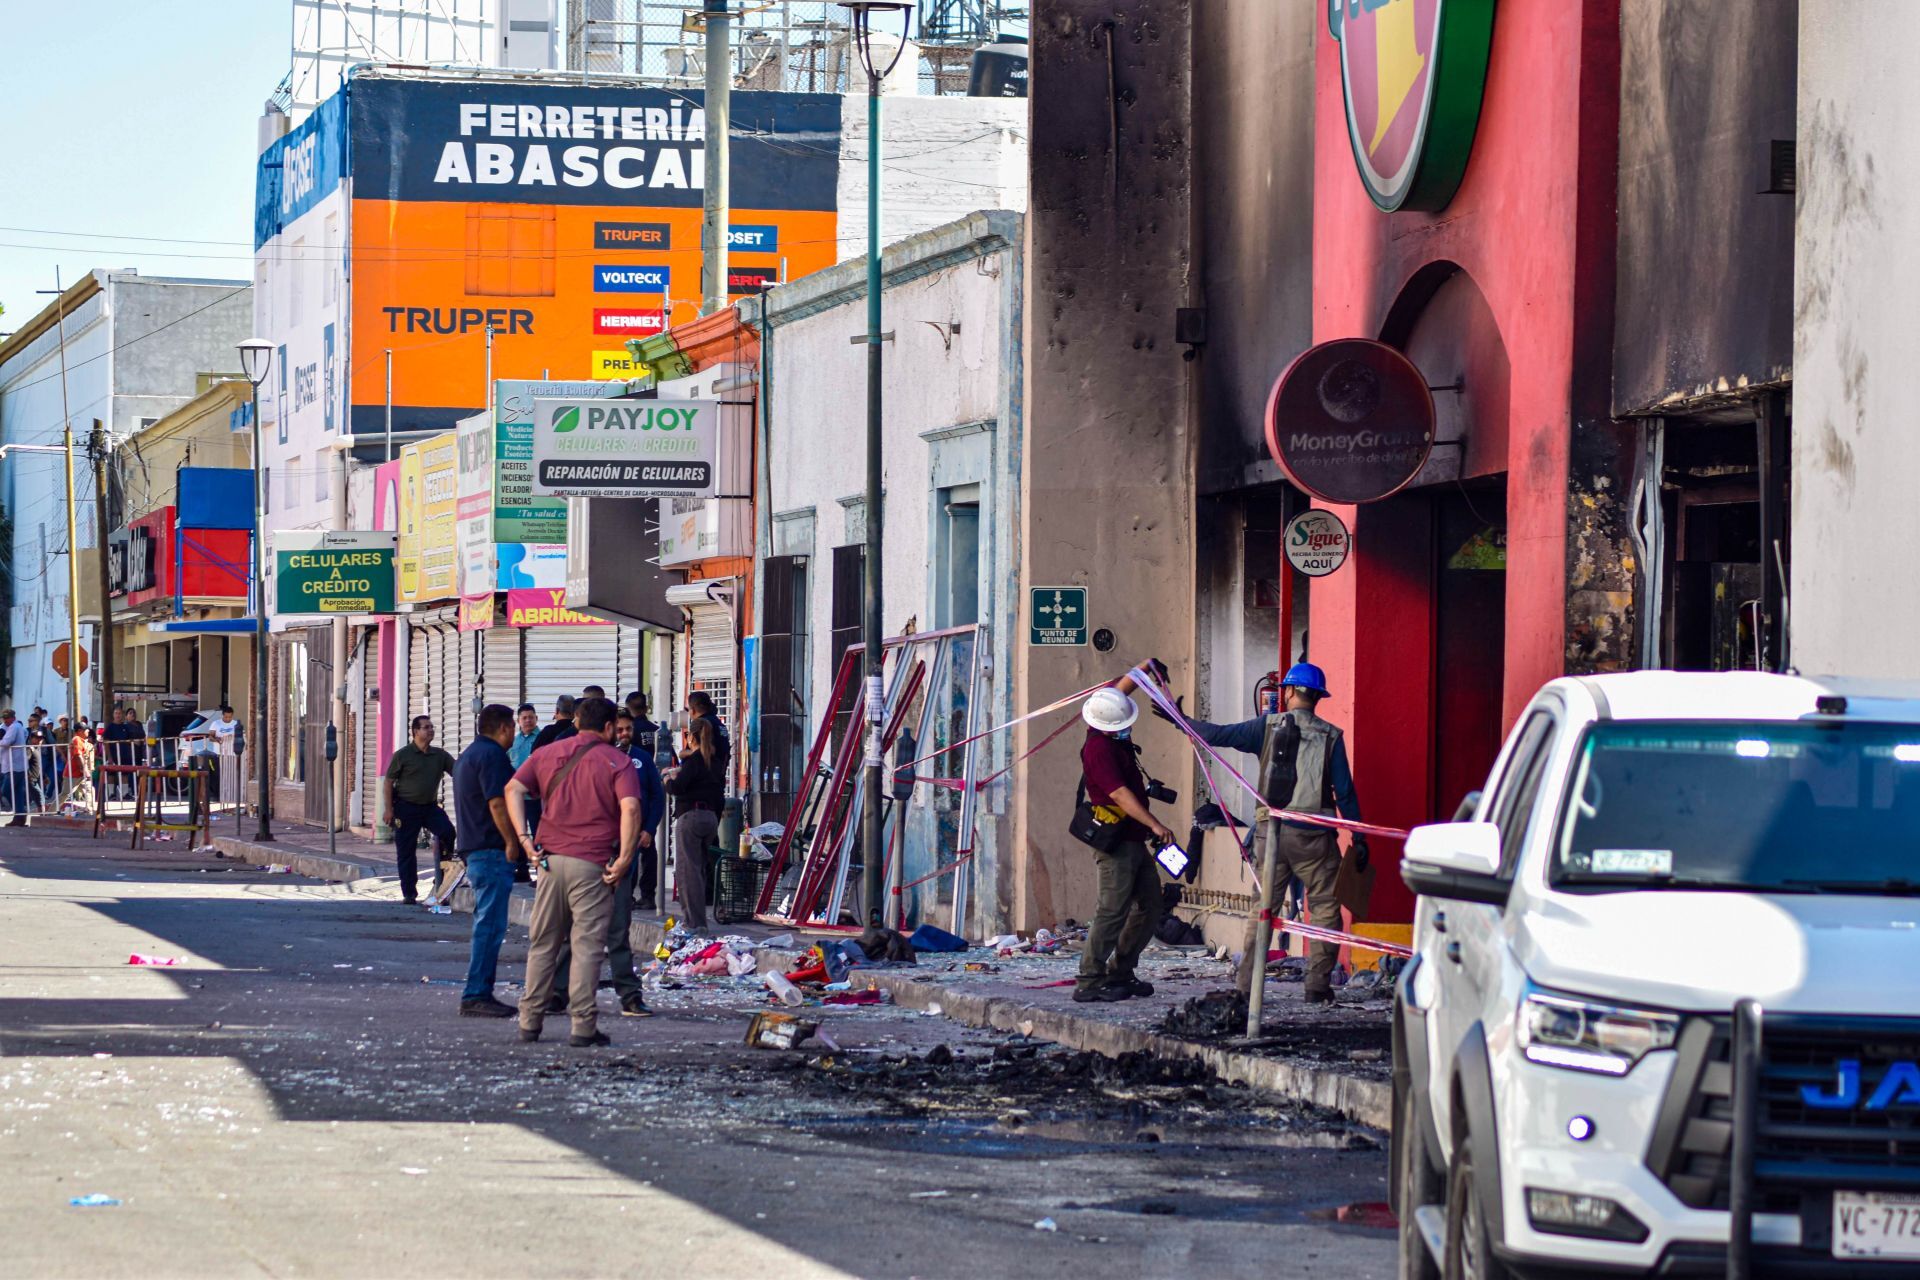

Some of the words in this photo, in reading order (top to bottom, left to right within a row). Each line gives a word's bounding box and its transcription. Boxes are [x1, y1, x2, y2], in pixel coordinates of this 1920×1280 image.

[460, 99, 706, 141] FERRETERÍA
[602, 229, 662, 242] TRUPER
[382, 307, 535, 335] TRUPER
[600, 316, 661, 327] HERMEX
[588, 408, 699, 431] PAYJOY
[557, 437, 626, 452] CELULARES
[631, 440, 638, 452] A
[1366, 453, 1379, 463] de
[546, 464, 621, 480] REPARACIÓN
[624, 467, 639, 480] DE
[642, 467, 705, 481] CELULARES
[1291, 520, 1343, 551] Sigue
[290, 552, 382, 568] CELULARES
[1303, 557, 1333, 568] AQUÍ
[330, 568, 342, 579] A
[302, 580, 370, 594] CREDITO
[1840, 1206, 1920, 1236] VC-772
